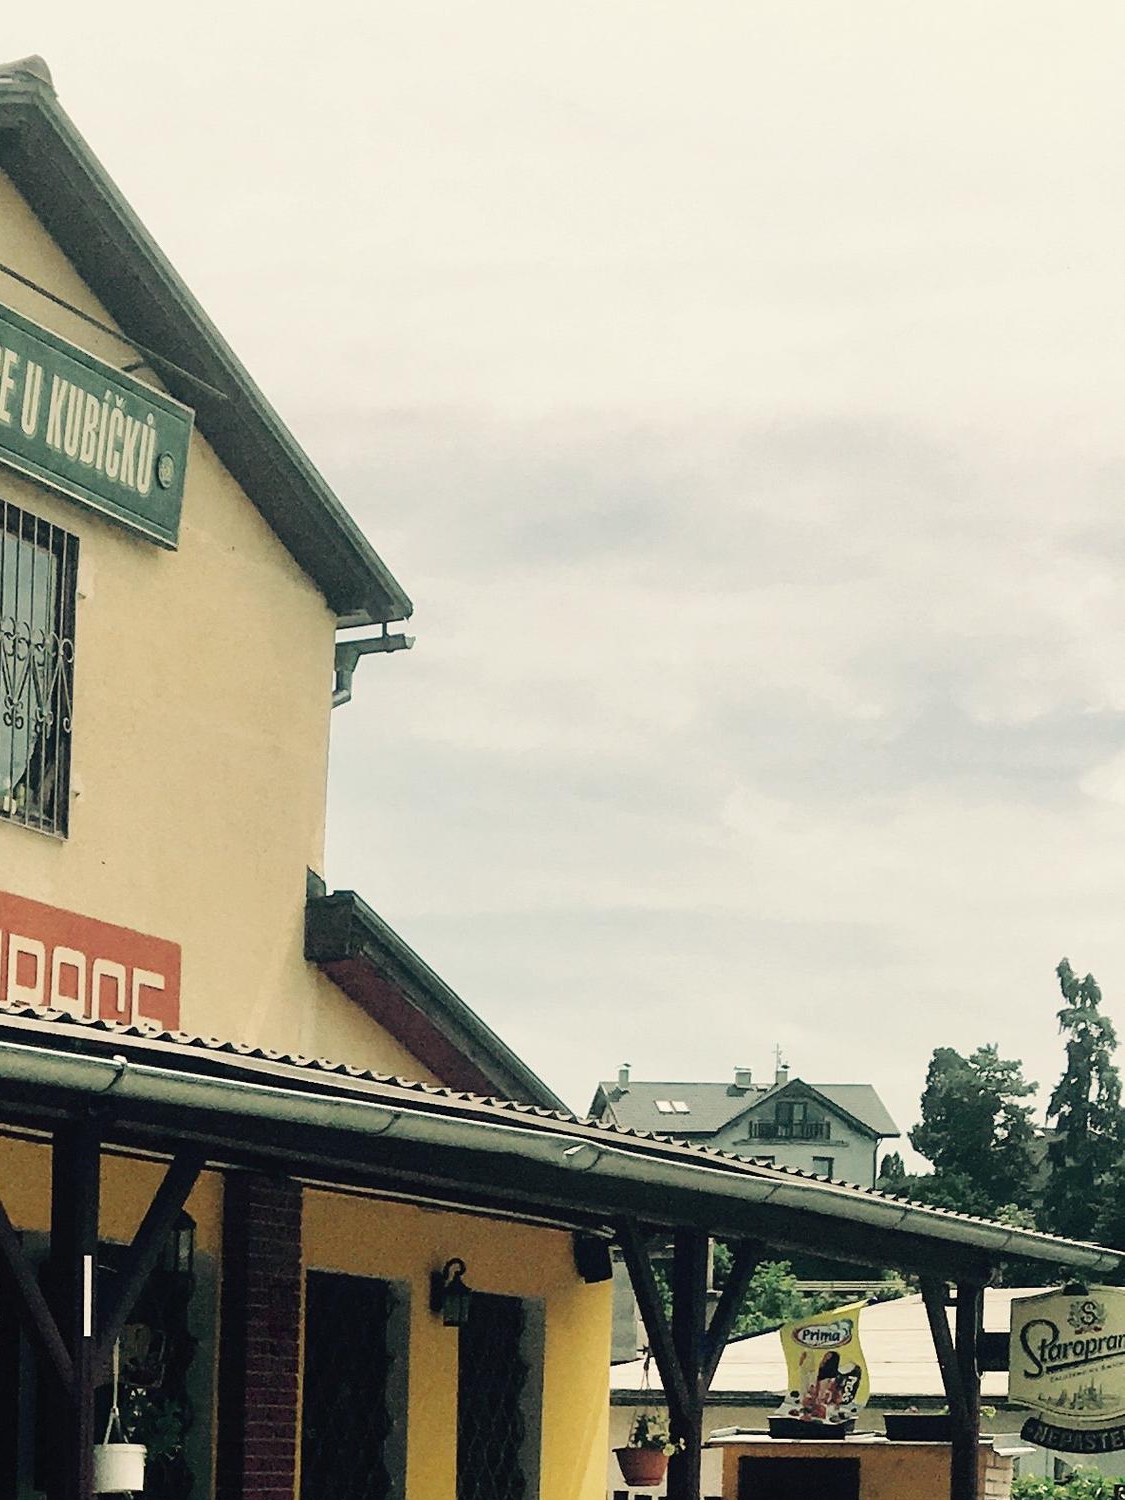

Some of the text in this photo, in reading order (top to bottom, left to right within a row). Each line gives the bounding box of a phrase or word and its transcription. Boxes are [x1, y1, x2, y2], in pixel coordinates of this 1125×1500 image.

[21, 360, 43, 437] U
[46, 374, 156, 494] KUBÍČKŮ
[802, 1329, 841, 1341] Prima
